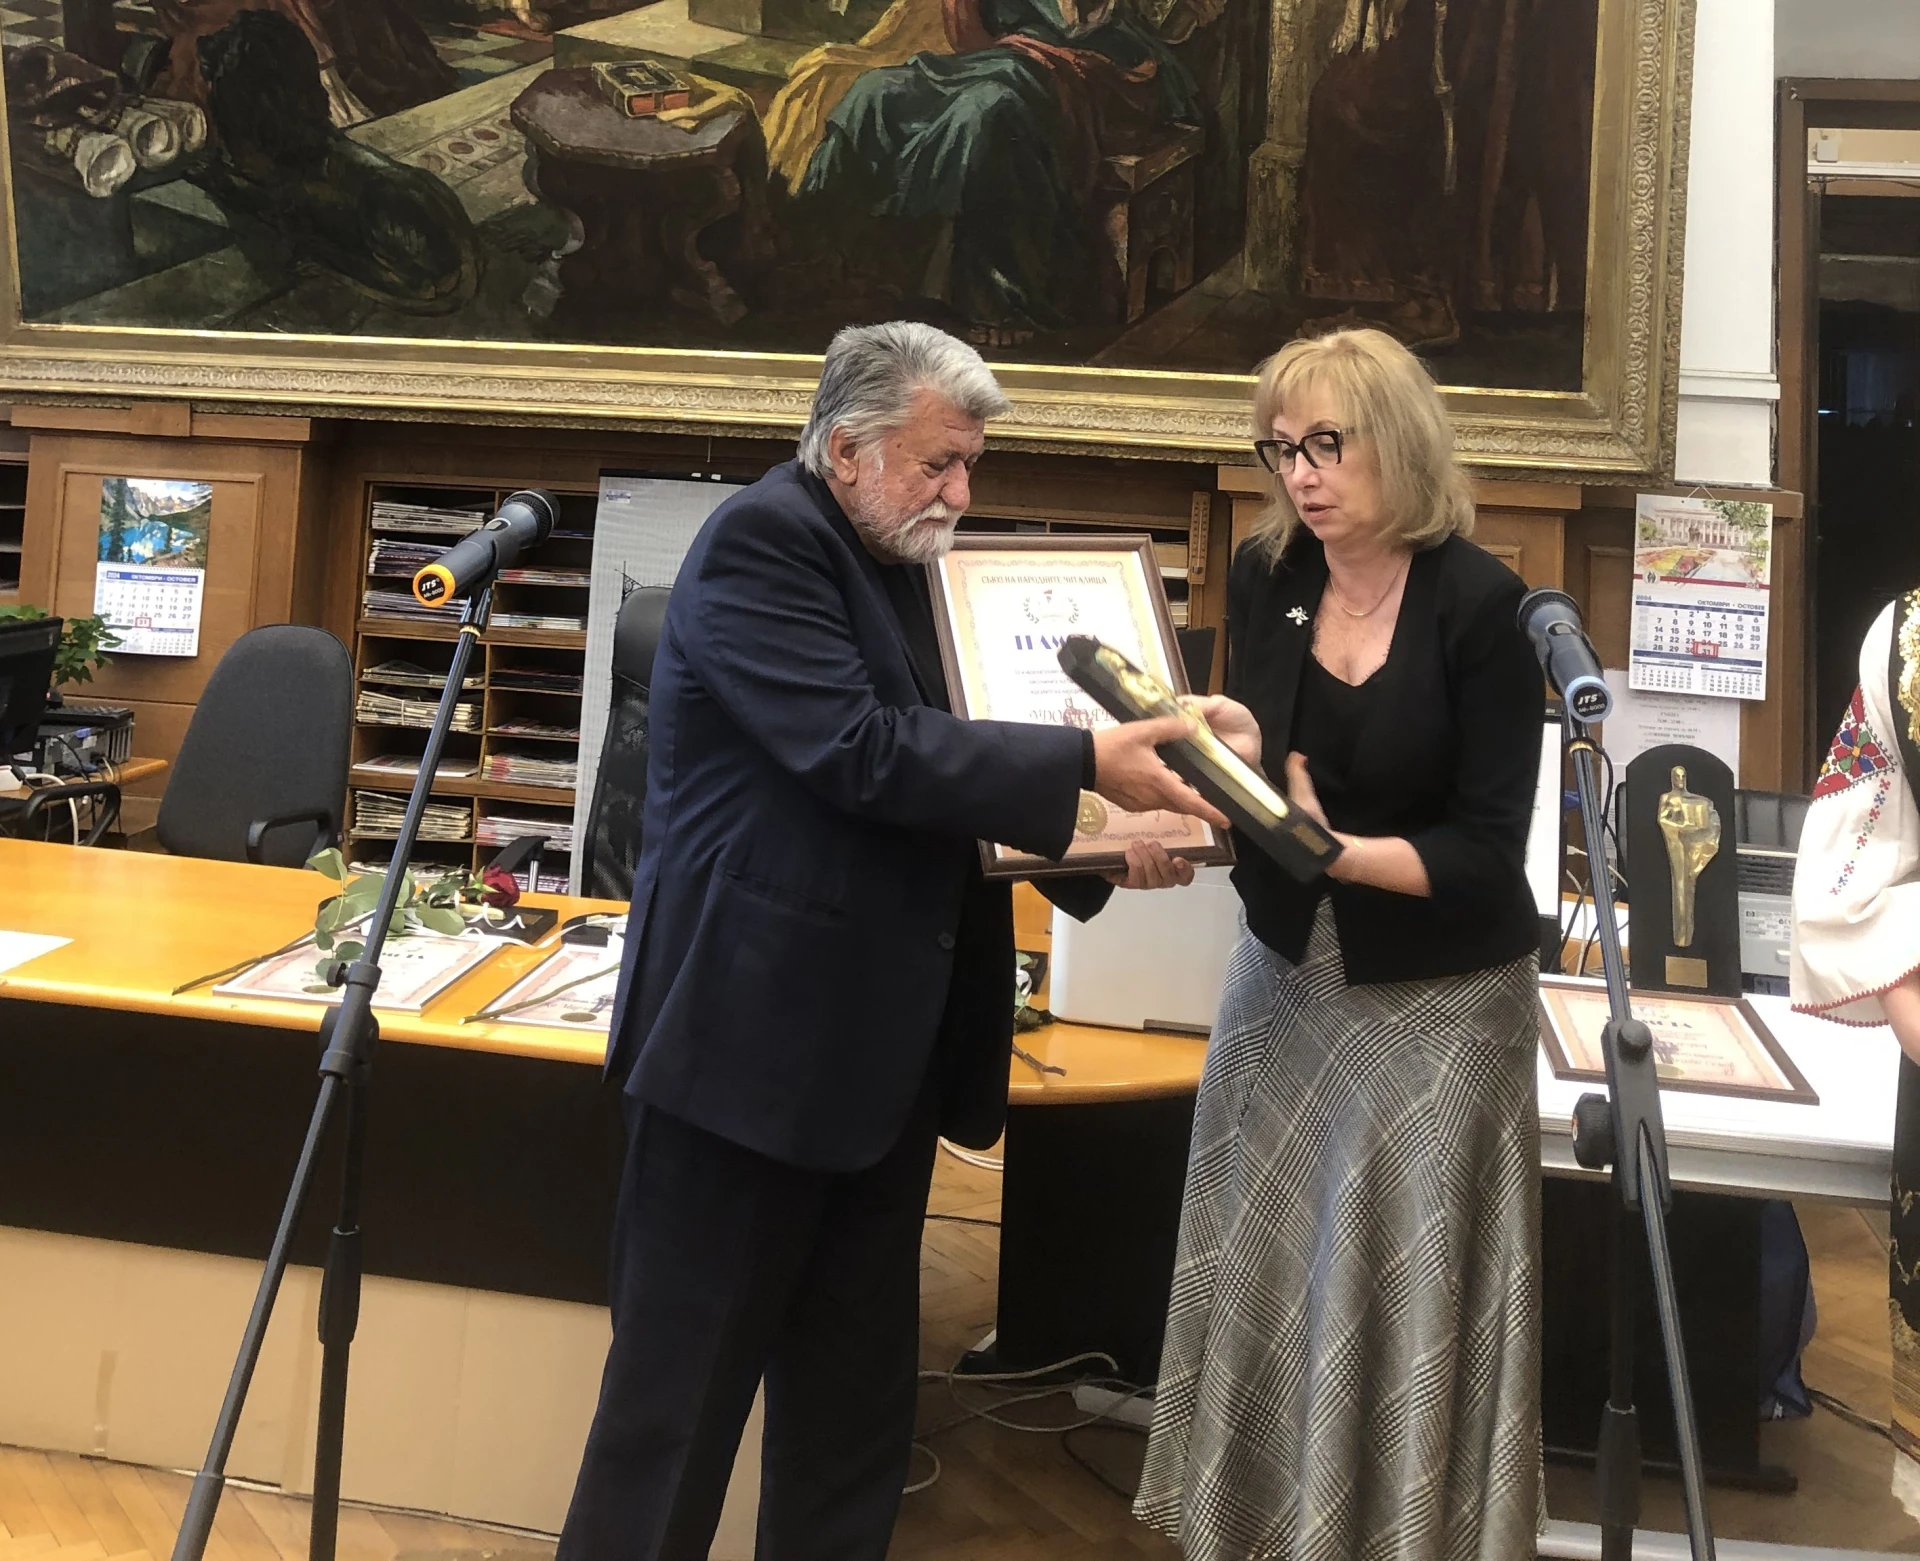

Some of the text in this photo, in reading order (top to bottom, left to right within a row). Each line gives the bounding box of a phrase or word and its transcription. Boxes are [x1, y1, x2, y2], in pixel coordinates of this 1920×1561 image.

[422, 580, 437, 592] JTS
[981, 576, 1003, 584] СЪЮЗ
[1005, 576, 1016, 584] НА
[1018, 576, 1061, 586] НАРОДНИТЕ
[1697, 600, 1730, 608] ОКТОМВРИ
[1737, 603, 1765, 611] OCTOBER
[1578, 694, 1598, 706] JTS
